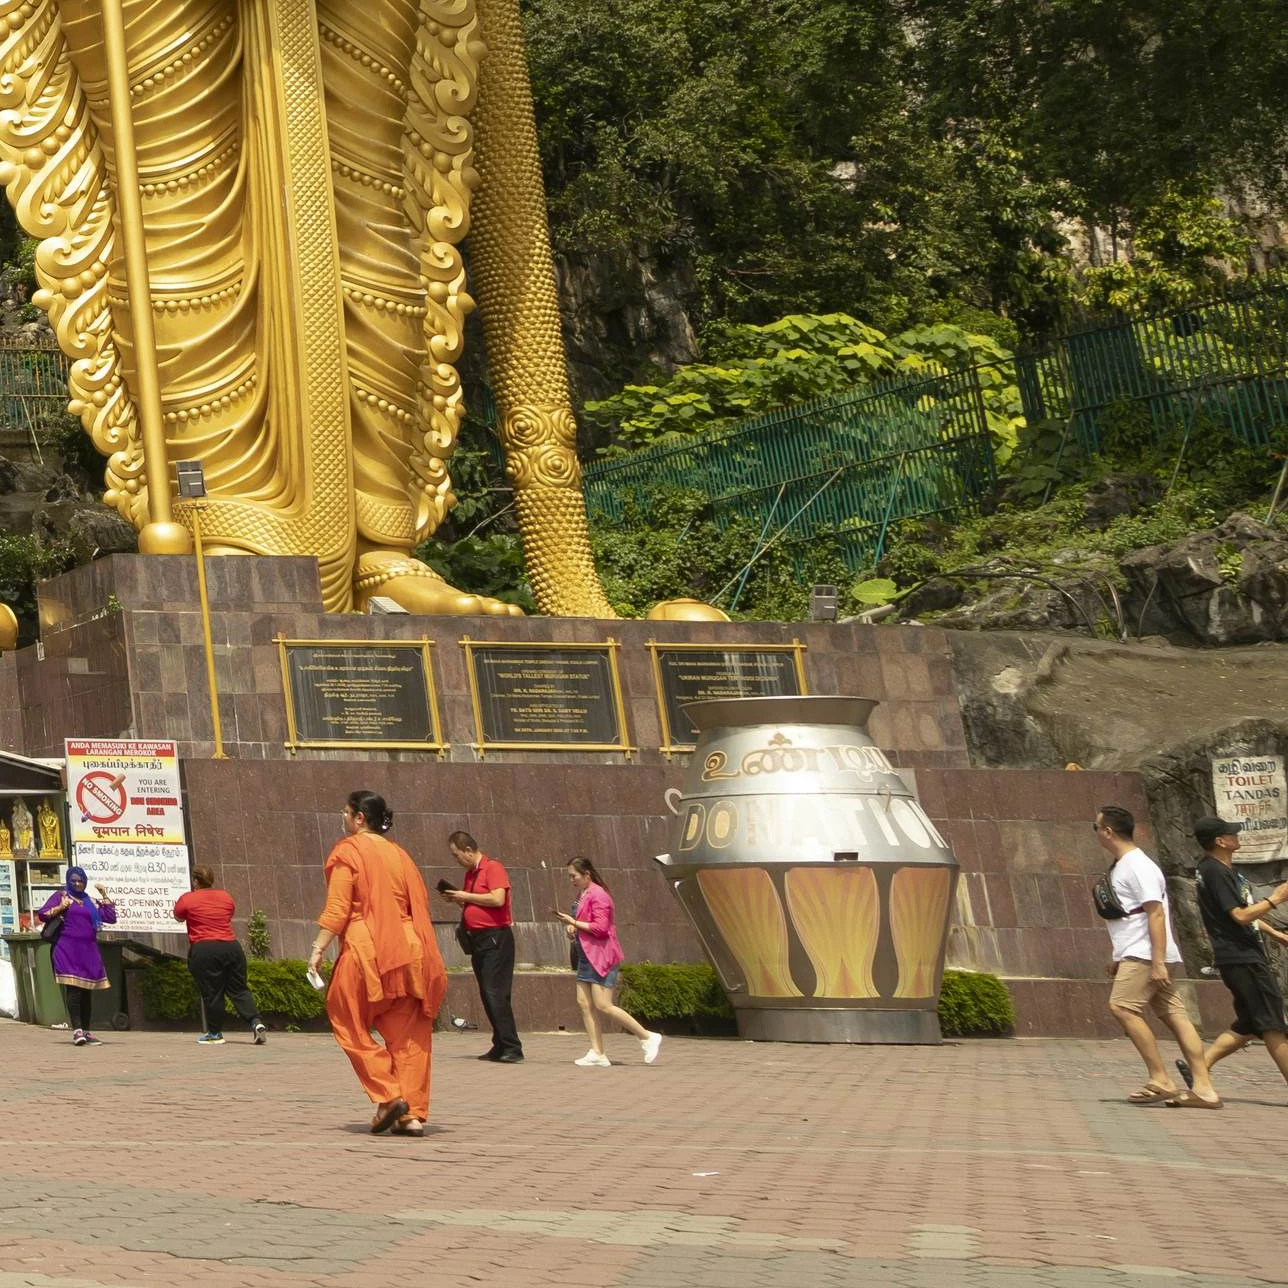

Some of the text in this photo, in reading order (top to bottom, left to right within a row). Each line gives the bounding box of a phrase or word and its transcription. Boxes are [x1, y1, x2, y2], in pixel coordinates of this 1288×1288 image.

[138, 743, 172, 751] KAWASAN
[1226, 775, 1274, 787] TOILET
[82, 778, 123, 816] NO SMOKING
[1223, 787, 1281, 800] TANDAS
[92, 861, 109, 872] 6.30
[147, 862, 167, 873] 8.30
[104, 887, 146, 895] TAIRCASE
[147, 887, 169, 896] GATE
[128, 899, 164, 907] OPENING
[144, 910, 152, 919] TO
